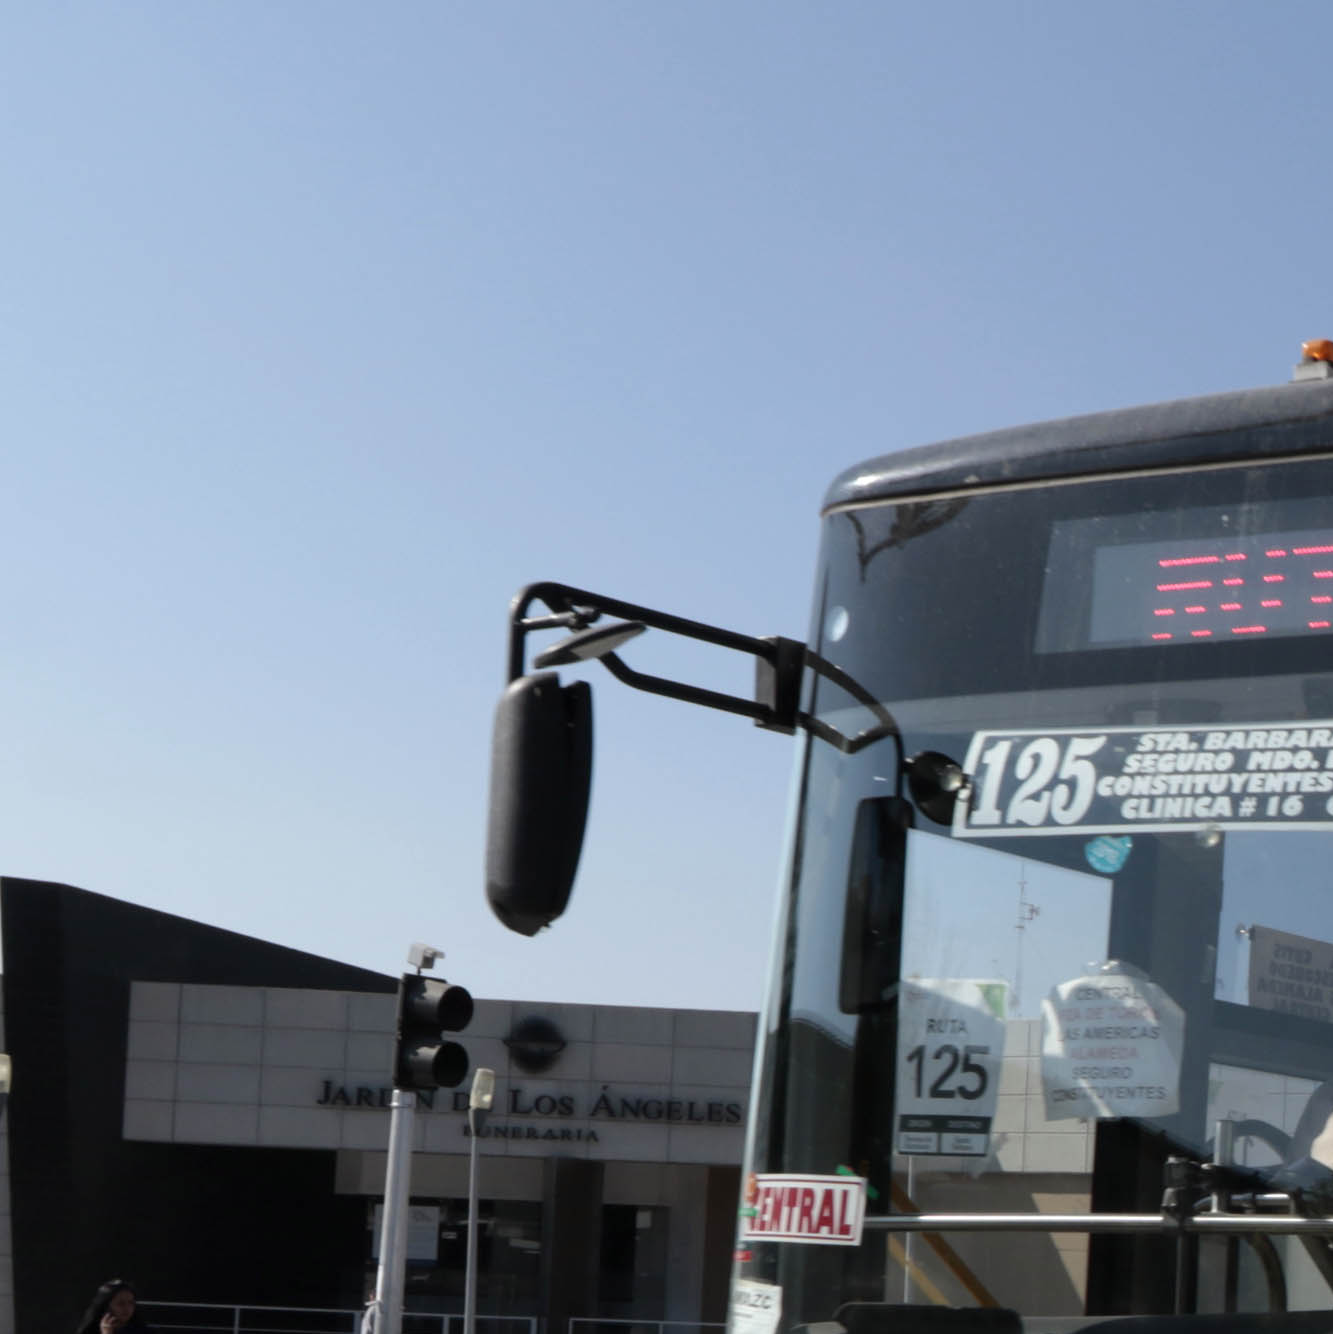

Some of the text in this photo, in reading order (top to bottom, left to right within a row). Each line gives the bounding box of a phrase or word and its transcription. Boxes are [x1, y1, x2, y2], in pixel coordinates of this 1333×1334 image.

[1138, 732, 1199, 752] STA.
[1123, 749, 1236, 773] SEGURO
[1246, 747, 1319, 772] MDO.
[969, 734, 1108, 826] 125
[1120, 796, 1232, 820] CLINICA
[1238, 797, 1258, 816] #
[1266, 795, 1304, 817] 16
[927, 1018, 968, 1034] RUTA
[1083, 1026, 1161, 1040] AMERICAS
[906, 1044, 990, 1101] 125
[511, 1088, 574, 1116] LOS
[590, 1085, 743, 1124] ÁNGELES
